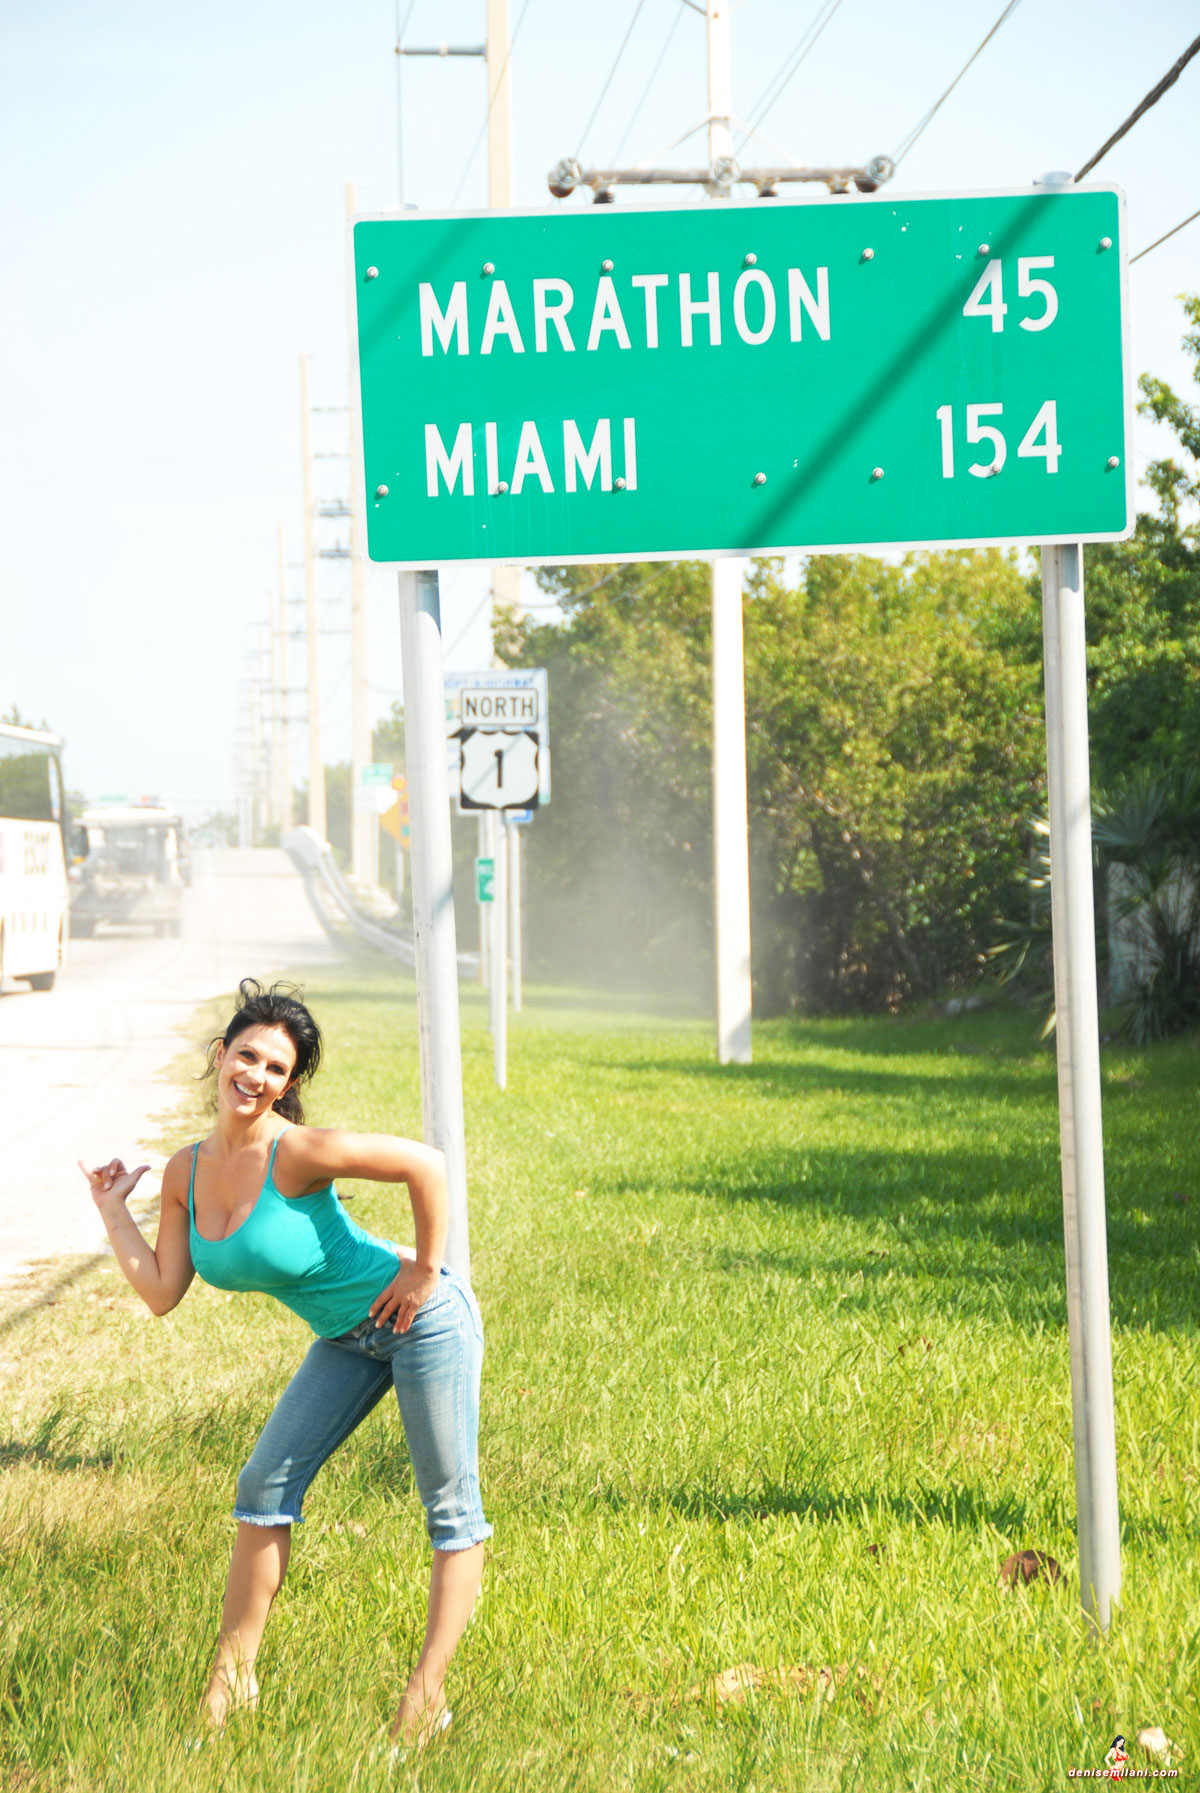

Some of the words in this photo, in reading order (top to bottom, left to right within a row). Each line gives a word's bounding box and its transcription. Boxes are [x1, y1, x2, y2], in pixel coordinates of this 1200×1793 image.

[418, 267, 830, 357] MARATHON
[962, 255, 1059, 333] 45
[424, 417, 638, 497] MIAMI
[935, 400, 1062, 479] 154
[465, 696, 534, 718] NORTH
[494, 749, 503, 789] 1
